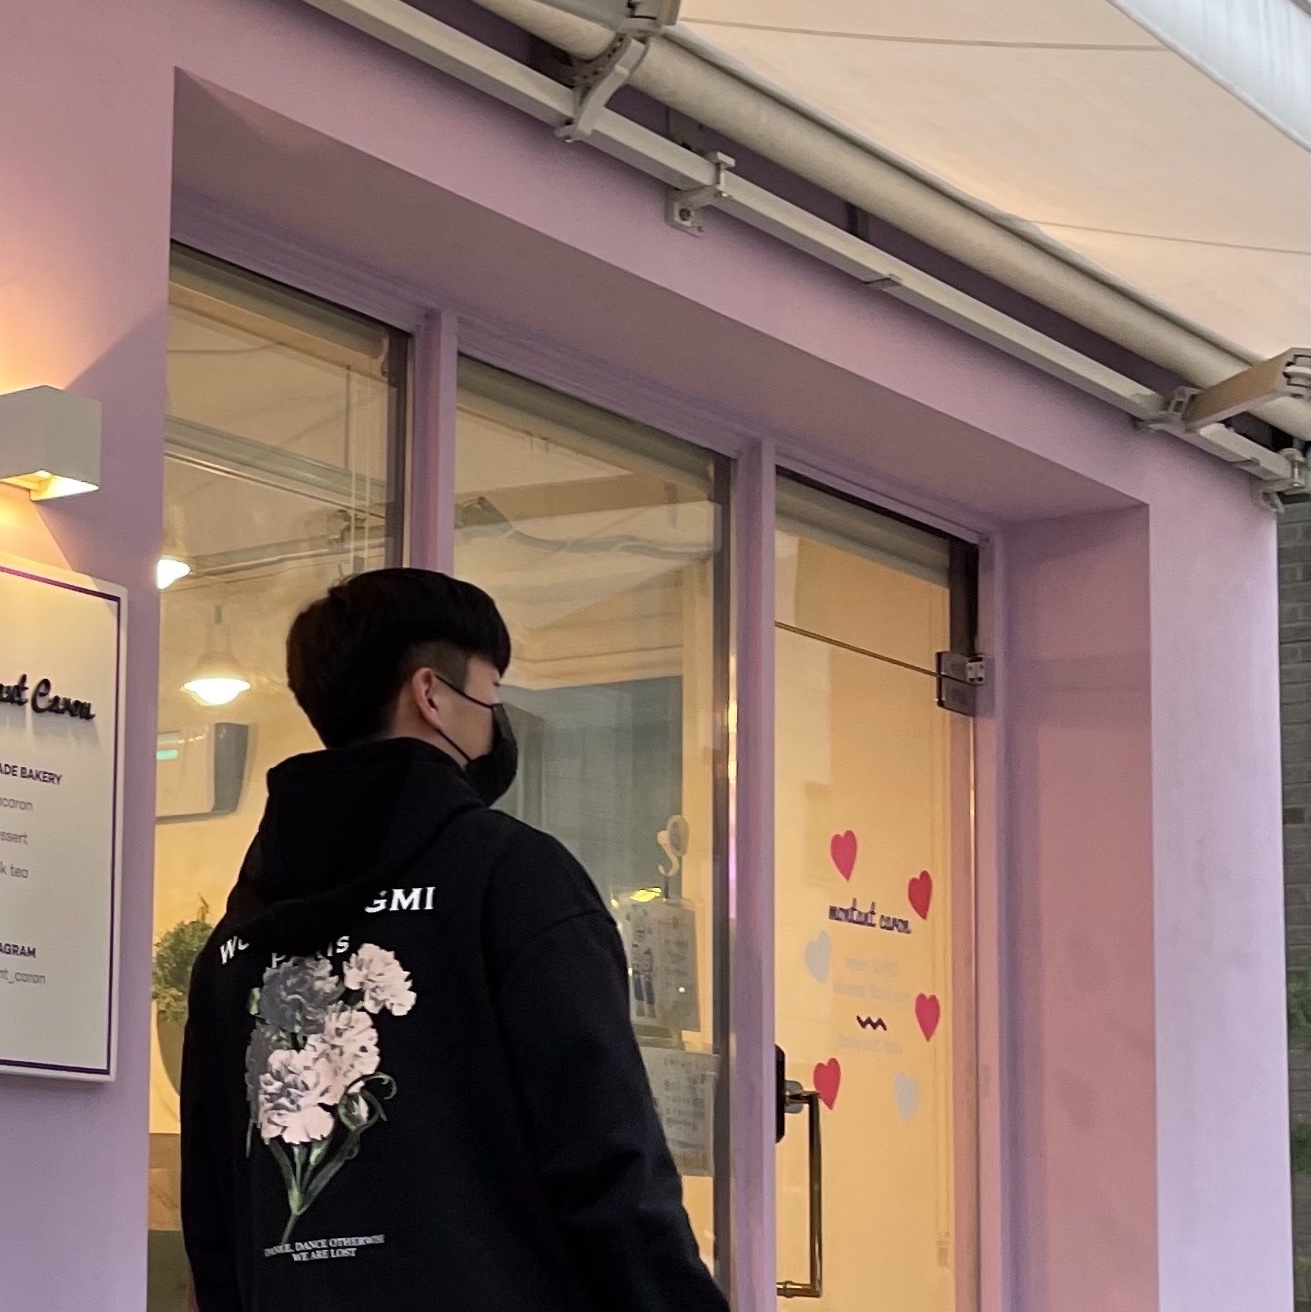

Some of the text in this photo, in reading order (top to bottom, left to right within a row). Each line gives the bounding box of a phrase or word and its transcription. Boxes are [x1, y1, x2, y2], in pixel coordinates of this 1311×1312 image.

[31, 678, 96, 720] Caron
[20, 767, 63, 785] BAKERY
[10, 864, 29, 879] tea
[310, 1249, 329, 1260] ARE
[330, 1247, 357, 1258] LOST
